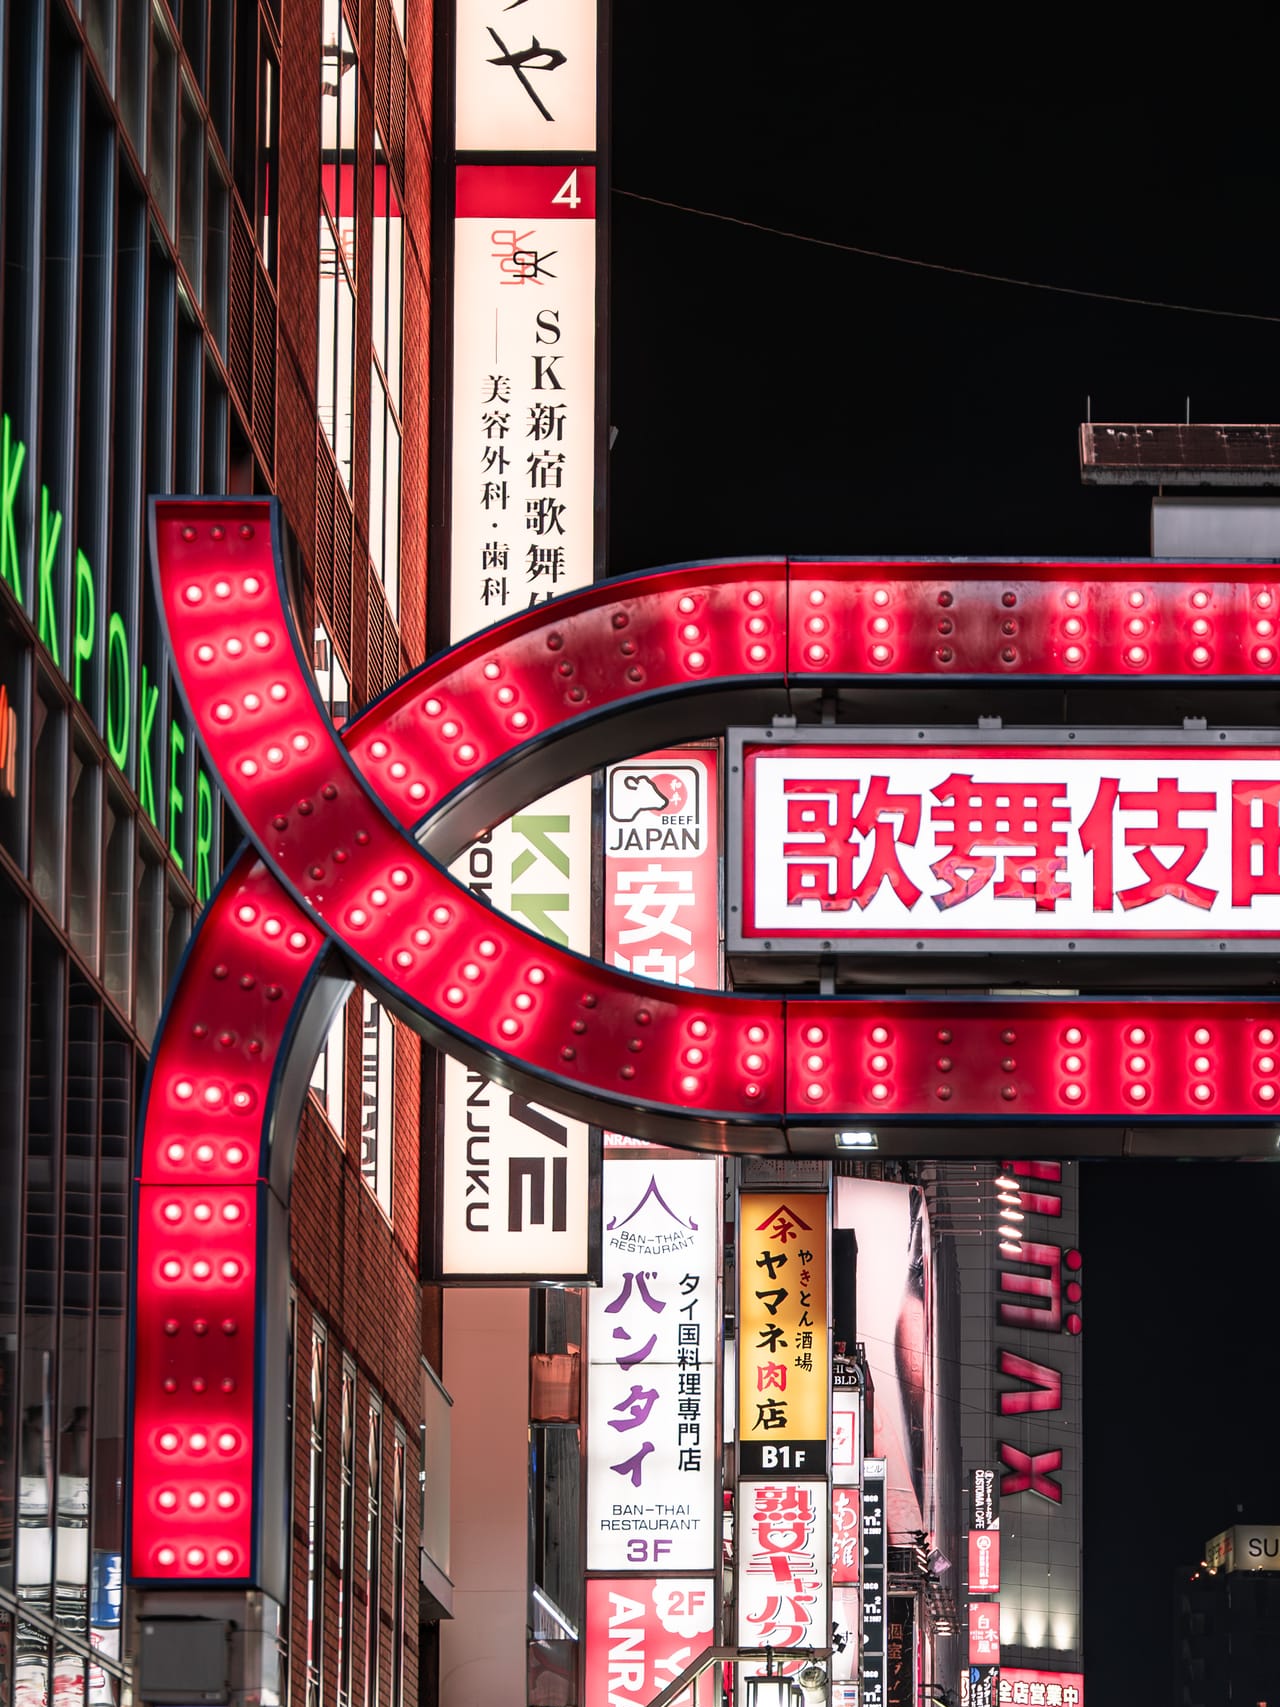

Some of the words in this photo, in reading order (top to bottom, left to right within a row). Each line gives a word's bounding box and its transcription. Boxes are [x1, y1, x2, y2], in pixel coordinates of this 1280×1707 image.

[486, 0, 567, 121] や
[552, 168, 581, 209] 4
[662, 815, 693, 825] BEEF
[610, 828, 700, 851] JAPAN
[609, 1236, 696, 1256] RESTAURANT
[620, 1230, 685, 1244] BAN-THAI
[795, 1249, 814, 1372] やきとん酒場
[752, 1251, 789, 1431] ヤマネ肉店
[604, 1270, 667, 1488] バンタイ
[677, 1273, 702, 1472] タイ国料理専門店
[834, 1376, 857, 1385] BLD
[762, 1445, 806, 1470] B1F
[612, 1504, 690, 1516] BAN-THAI
[600, 1518, 700, 1531] RESTAURANT
[627, 1539, 673, 1562] 3F
[668, 1590, 706, 1616] 2F
